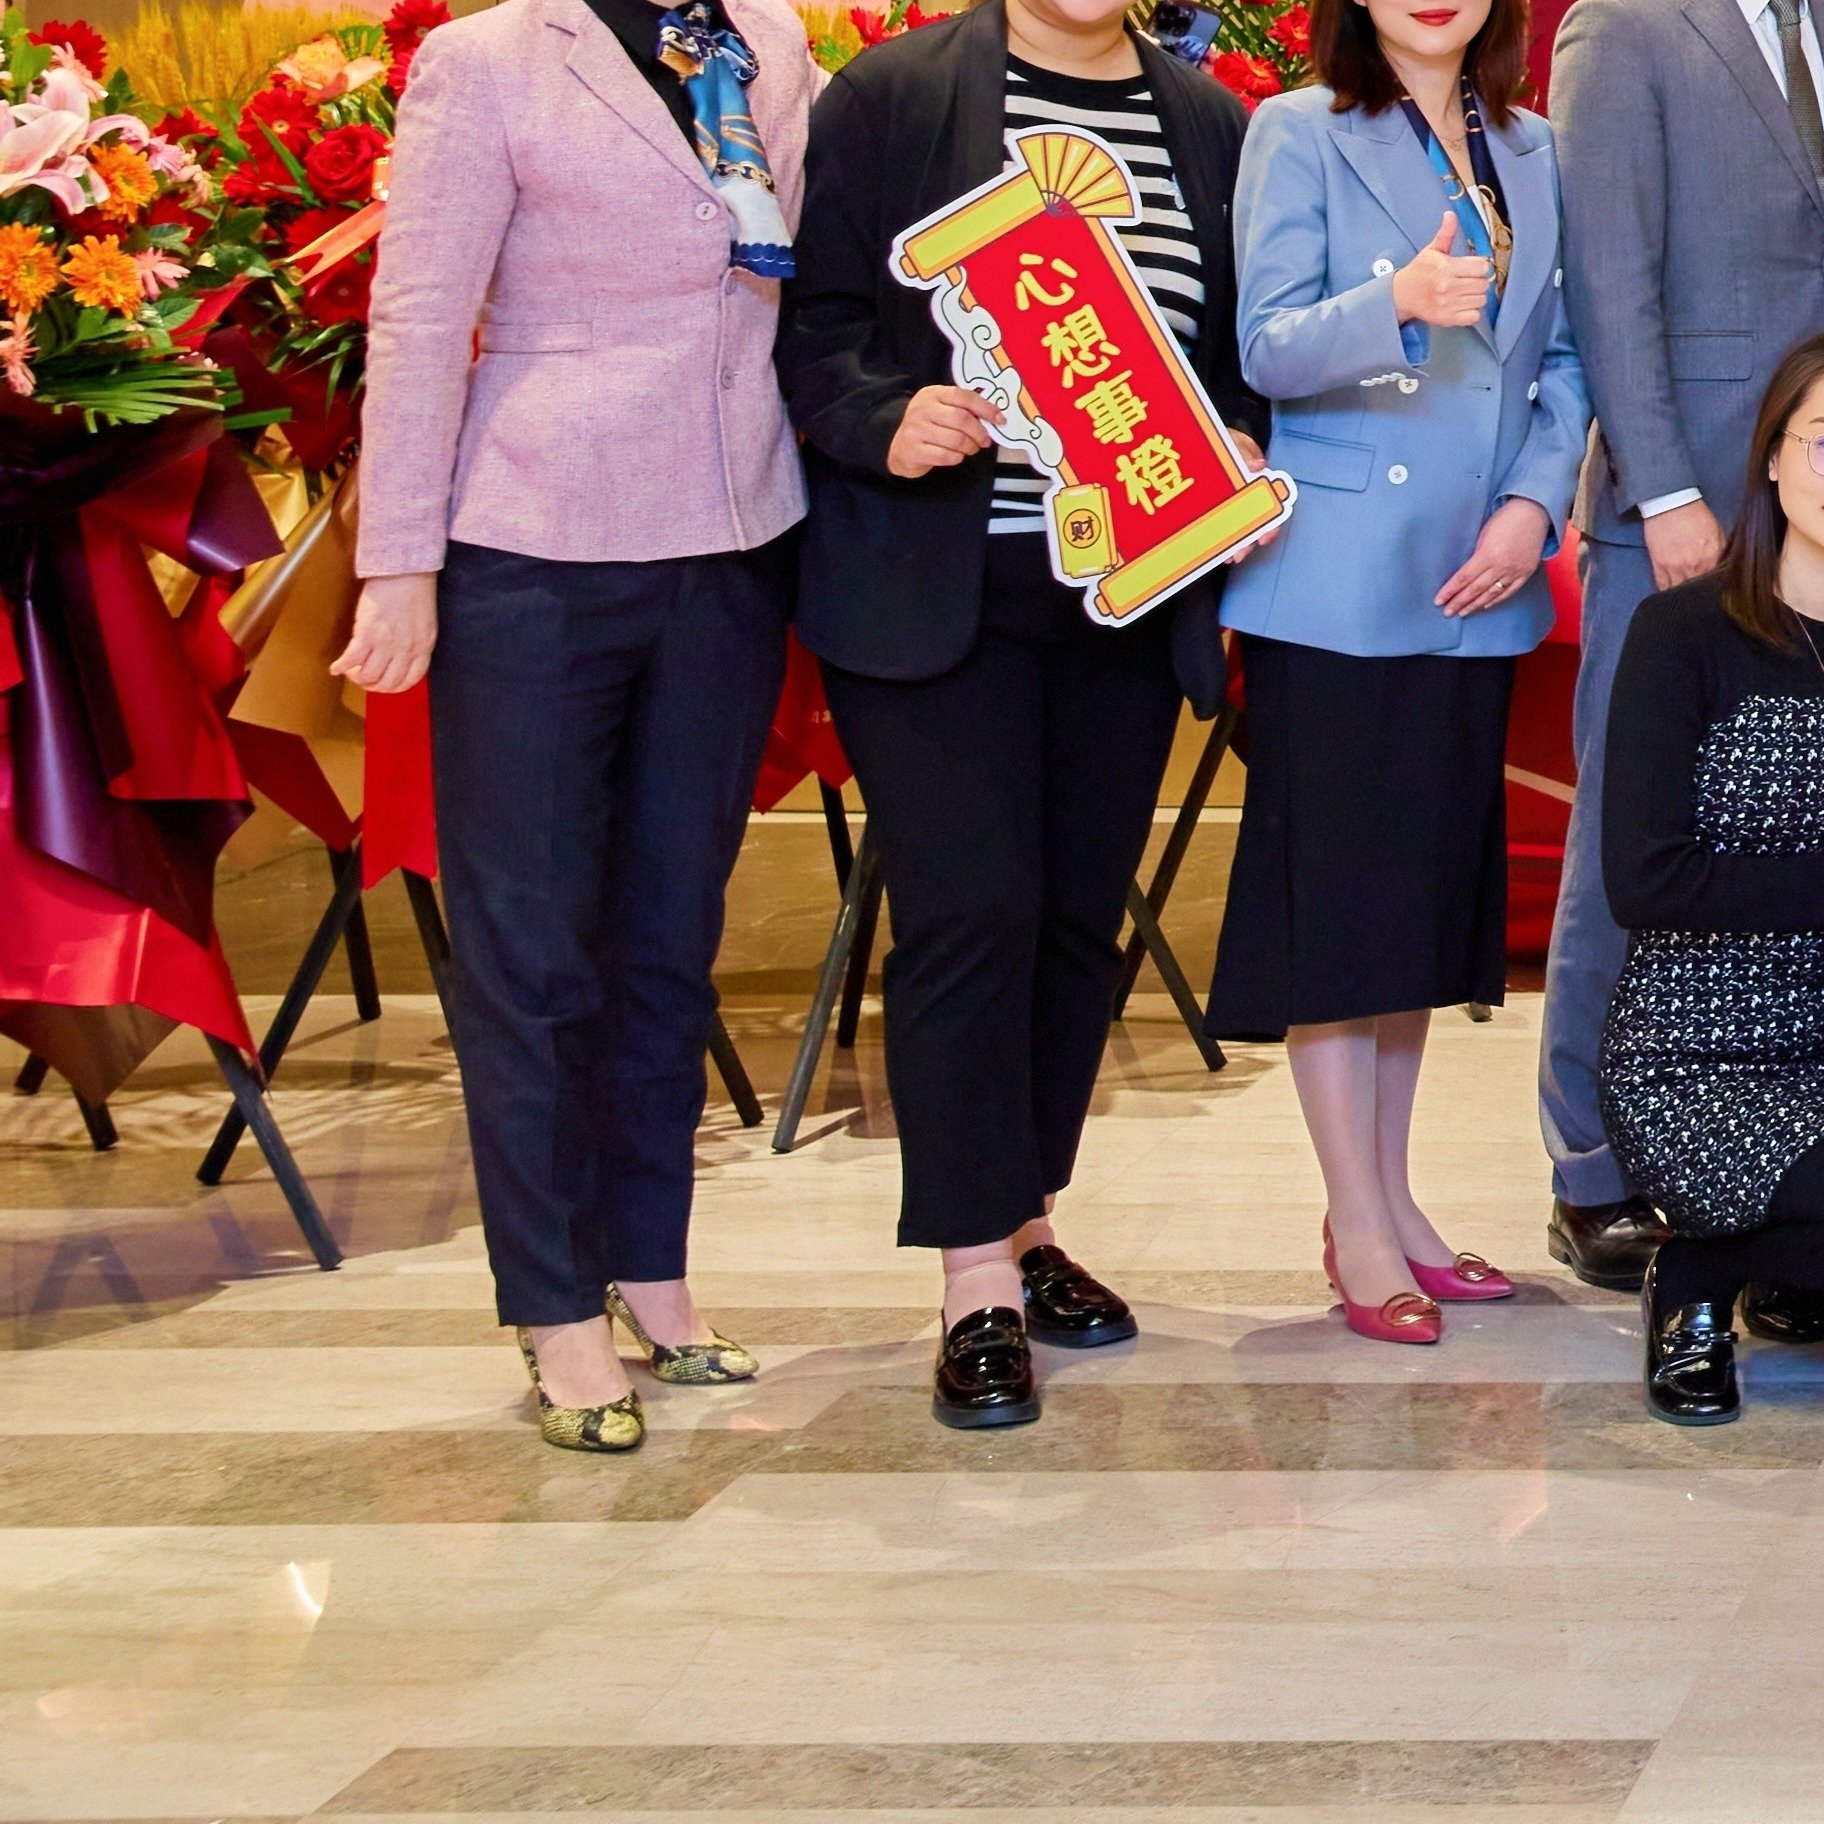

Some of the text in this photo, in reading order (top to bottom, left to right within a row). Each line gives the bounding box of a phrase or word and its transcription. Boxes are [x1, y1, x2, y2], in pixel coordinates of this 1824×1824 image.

[1014, 253, 1194, 516] 心想事橙
[1070, 520, 1096, 543] 财
